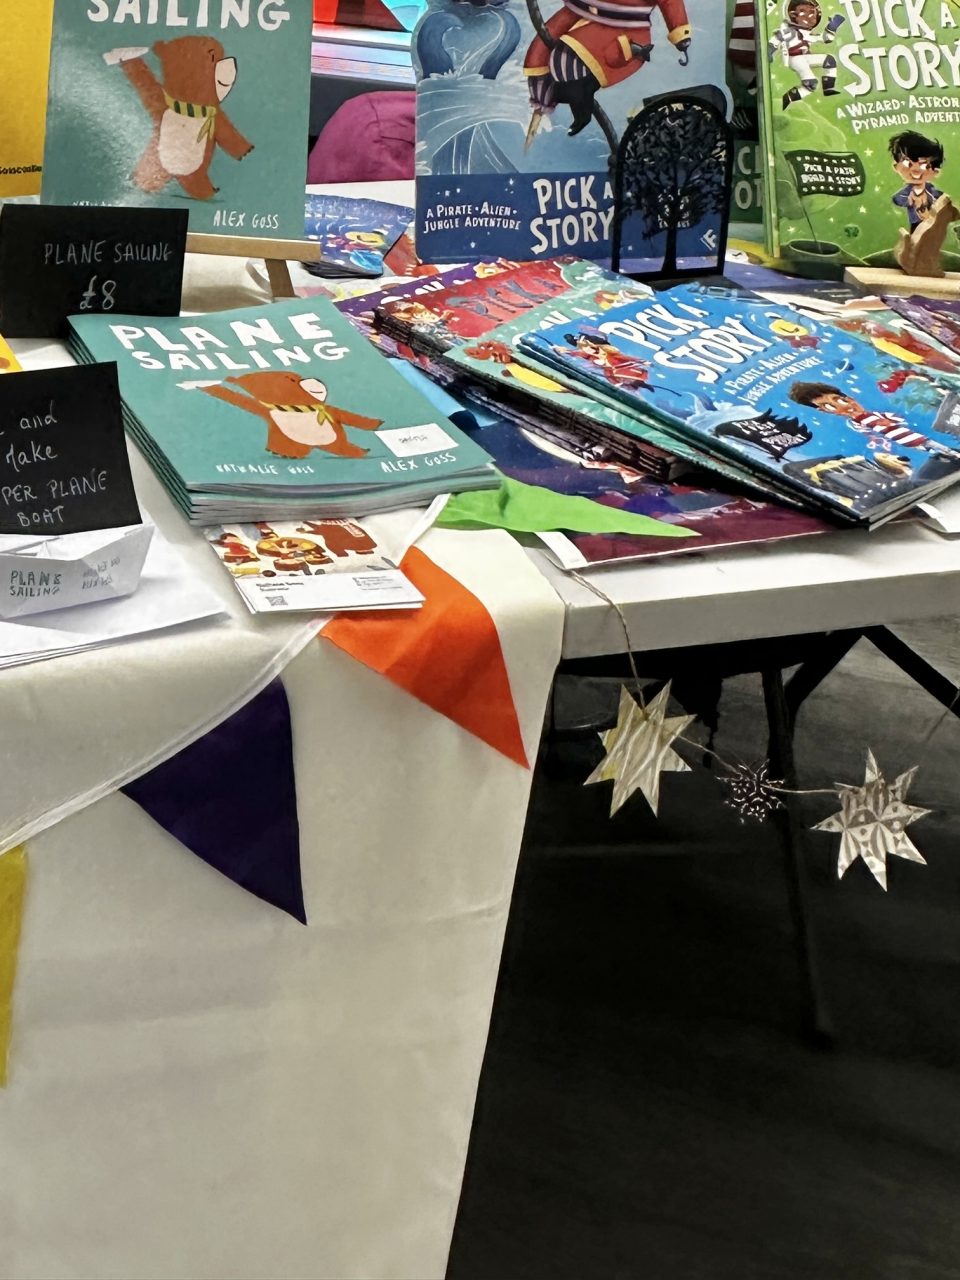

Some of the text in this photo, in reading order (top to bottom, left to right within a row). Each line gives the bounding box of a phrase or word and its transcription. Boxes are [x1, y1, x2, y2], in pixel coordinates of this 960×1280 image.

[940, 2, 959, 29] A
[838, 39, 960, 98] STORY
[836, 107, 847, 120] A
[532, 174, 615, 216] PICK A
[213, 209, 245, 228] ALEX
[426, 208, 434, 219] A
[529, 205, 616, 255] STORY
[43, 240, 107, 265] PLANE
[79, 274, 117, 310] £8
[108, 312, 335, 351] PLANE
[599, 303, 711, 352] PICK
[677, 303, 711, 318] A
[131, 341, 351, 371] SAILING
[652, 315, 774, 384] STORY
[19, 399, 59, 430] and
[380, 452, 457, 474] ALEX GOSS
[46, 468, 108, 500] PLANE
[17, 505, 65, 528] BOAT
[9, 569, 62, 586] PLANE
